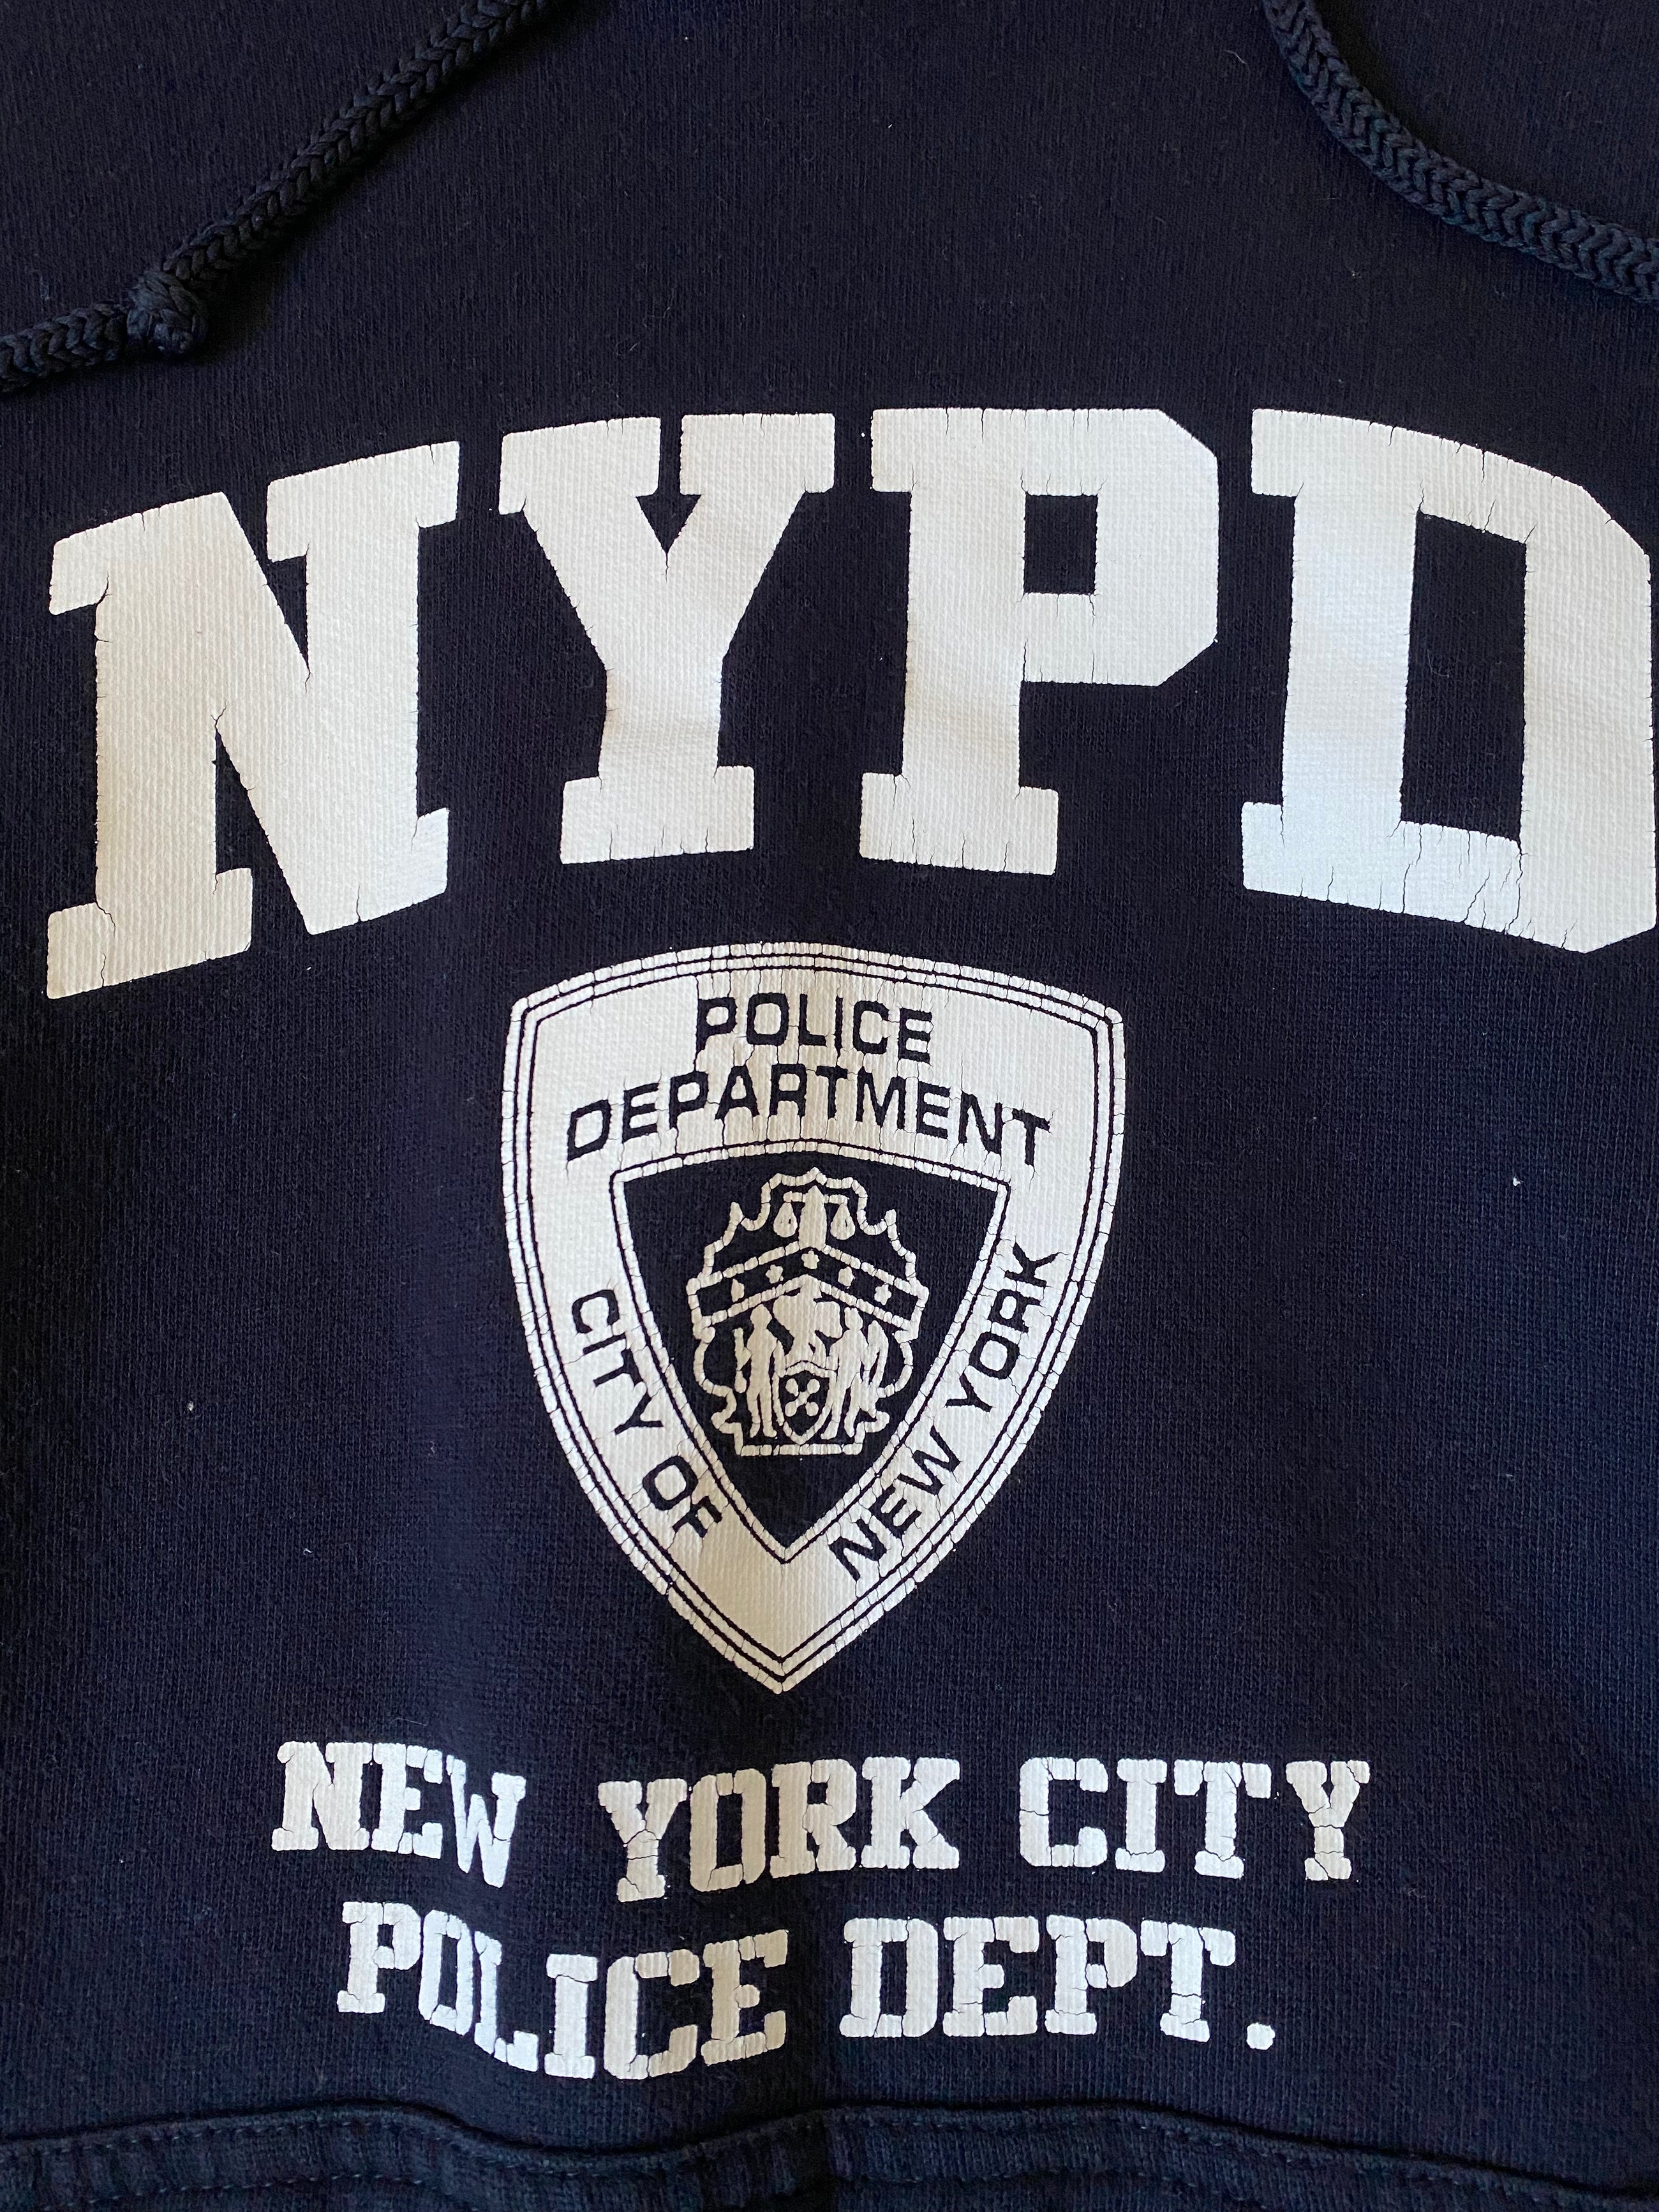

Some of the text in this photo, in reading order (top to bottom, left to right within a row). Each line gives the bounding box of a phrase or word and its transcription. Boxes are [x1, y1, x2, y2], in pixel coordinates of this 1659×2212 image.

[47, 407, 1657, 999] NYPD
[697, 991, 934, 1064] POLICE
[567, 1064, 1052, 1166] DEPARTMENT
[571, 1240, 1055, 1582] CITY OF NEW YORK
[271, 1741, 1371, 1903] NEW YORK CITY
[337, 1901, 1276, 2080] POLICE DEPT.
